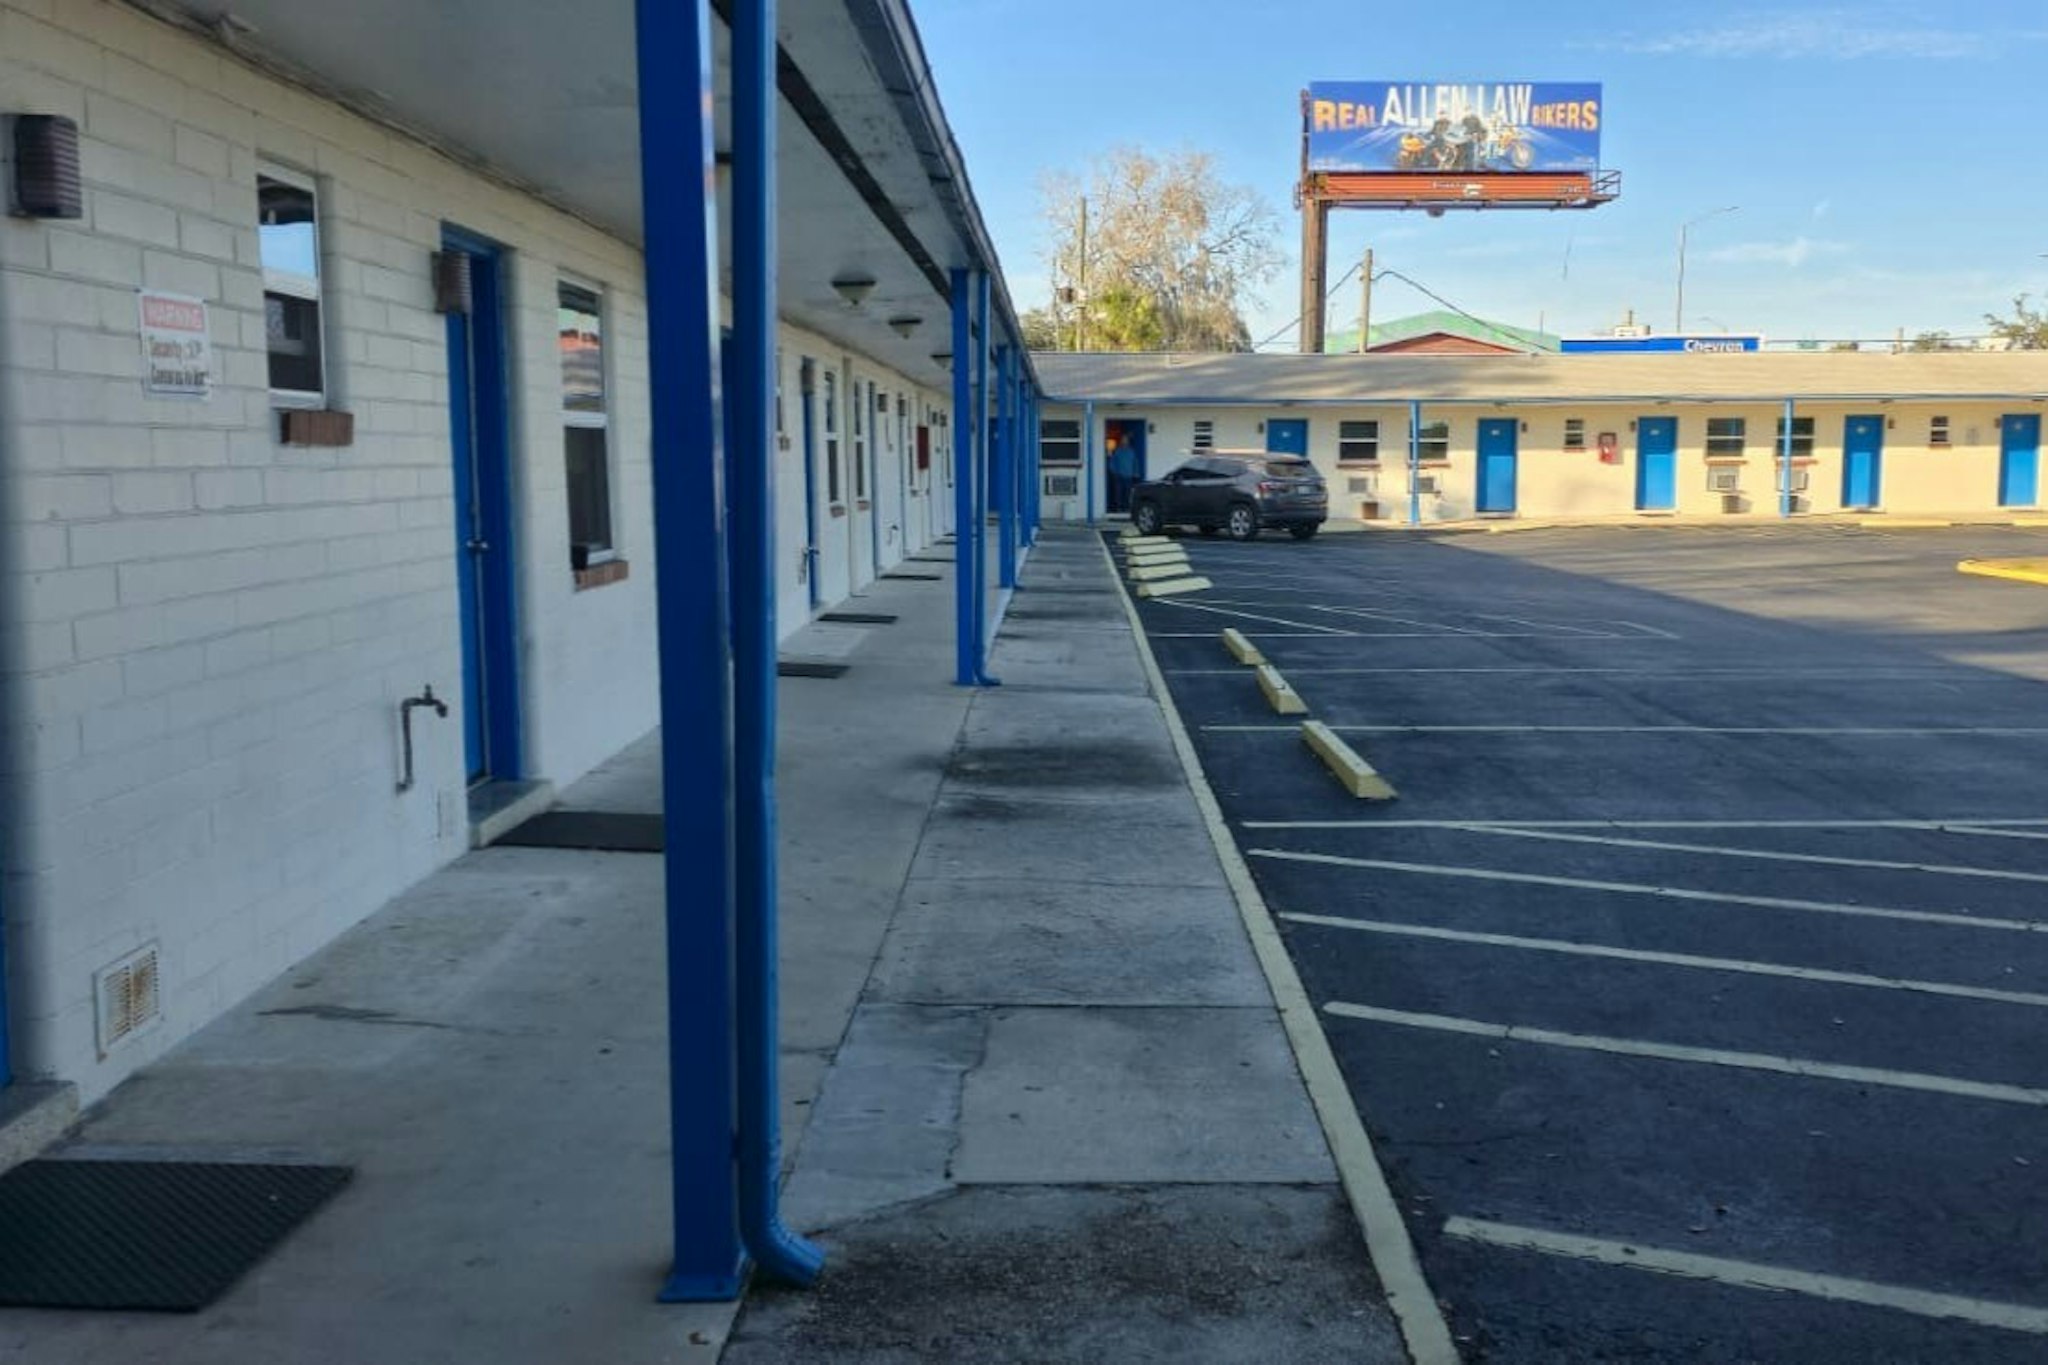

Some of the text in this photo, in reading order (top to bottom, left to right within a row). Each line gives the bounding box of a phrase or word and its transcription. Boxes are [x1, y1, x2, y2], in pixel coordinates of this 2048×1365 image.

[1313, 84, 1598, 132] REAL ALLEN LAW BIKERS
[1684, 339, 1744, 353] Chevron
